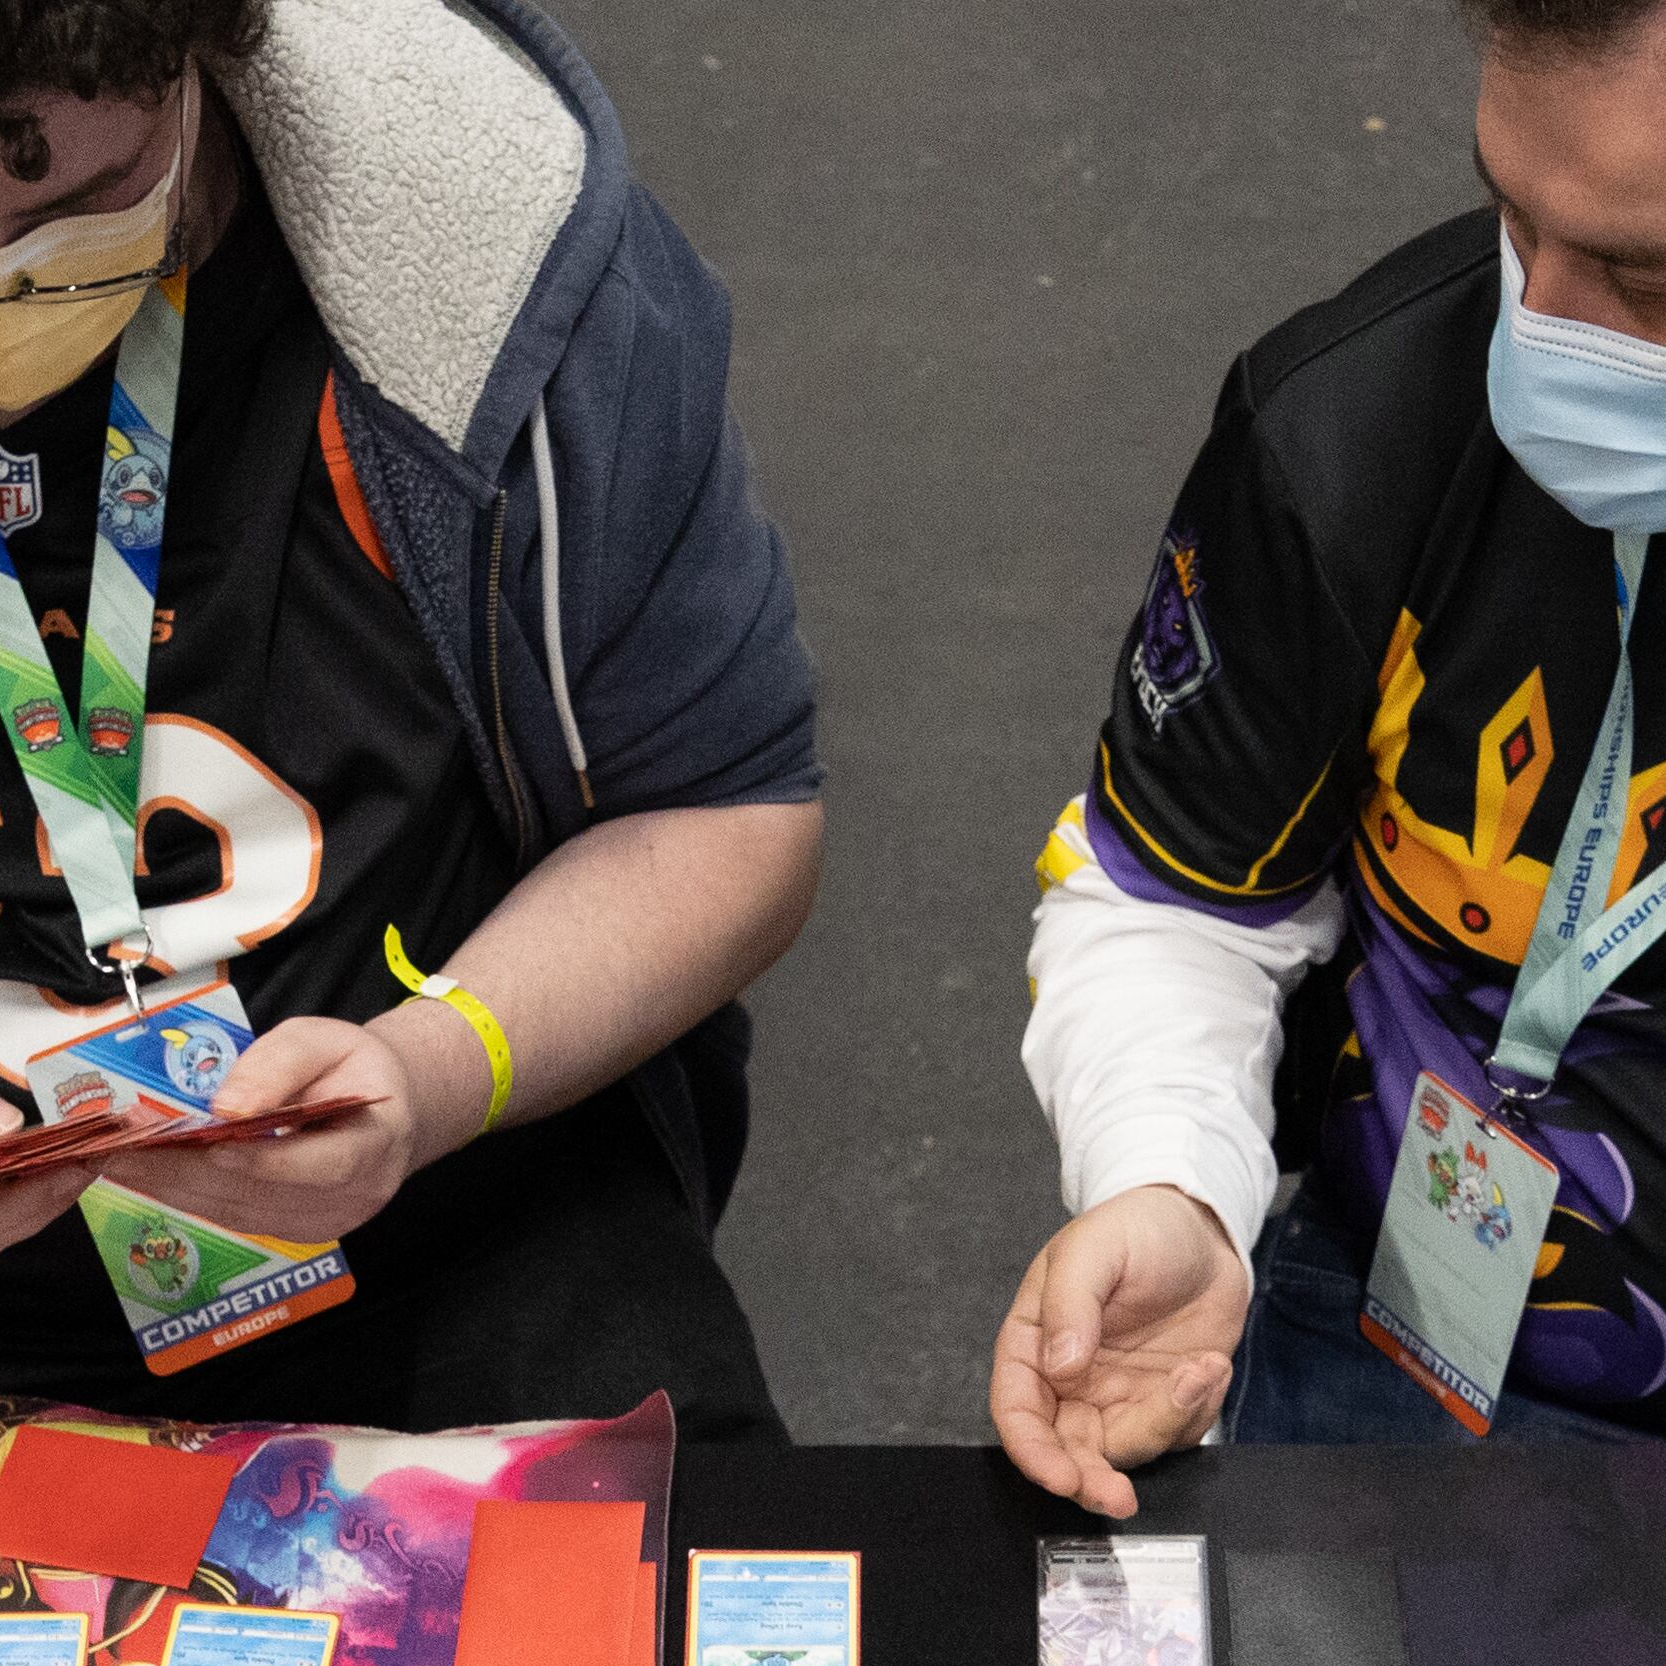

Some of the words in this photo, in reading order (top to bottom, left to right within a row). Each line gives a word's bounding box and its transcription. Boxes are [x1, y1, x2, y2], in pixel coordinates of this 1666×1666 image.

[1558, 827, 1603, 940] EUROPE
[141, 1254, 342, 1350] COMPETITOR
[212, 1306, 291, 1346] EUROPE
[1366, 1299, 1493, 1417] COMPETITOR
